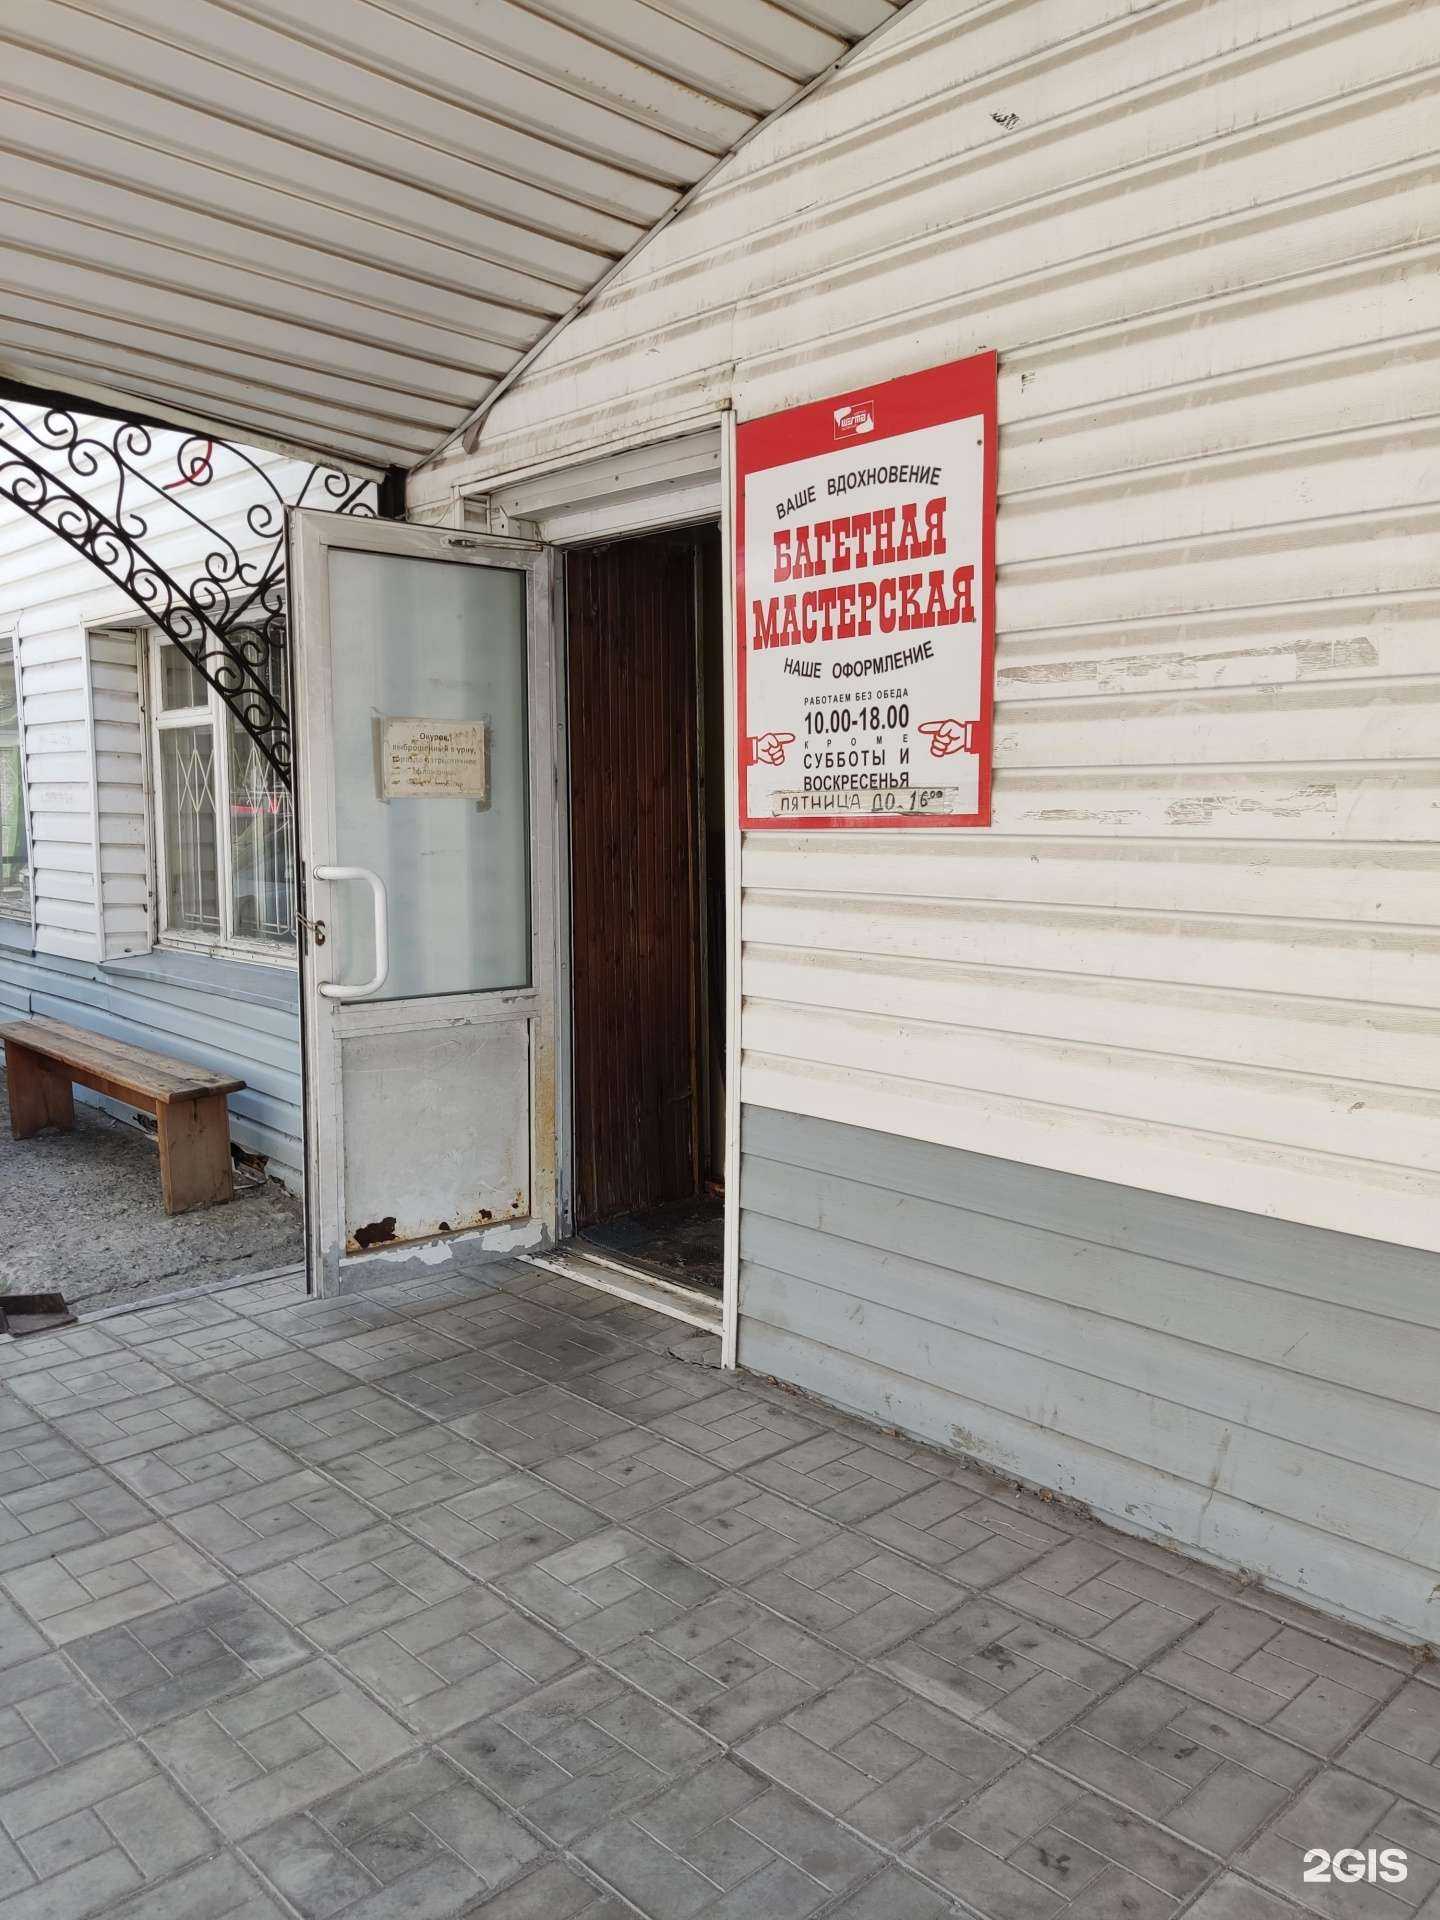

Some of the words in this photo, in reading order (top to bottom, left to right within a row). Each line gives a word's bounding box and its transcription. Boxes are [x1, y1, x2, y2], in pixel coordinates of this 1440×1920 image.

[775, 486, 816, 520] ВАШЕ
[827, 465, 942, 496] ВДОХНОВЕНИЕ
[773, 496, 947, 583] БАГЕТНАЯ
[752, 565, 975, 650] МАСТЕРСКАЯ
[784, 657, 822, 679] НАШЕ
[832, 640, 934, 679] ОФОРМЛЕНИЕ
[804, 693, 851, 706] РАБОТАЕМ
[855, 691, 872, 701] БЕЗ
[876, 688, 909, 699] ОБЕДА
[804, 704, 909, 735] 10.00-18.00
[803, 750, 886, 769] СУББОТЫ
[900, 748, 909, 764] И
[804, 772, 909, 792] ВОСКРЕСЕНЬЯ
[781, 794, 861, 812] ПЯТНИЦА
